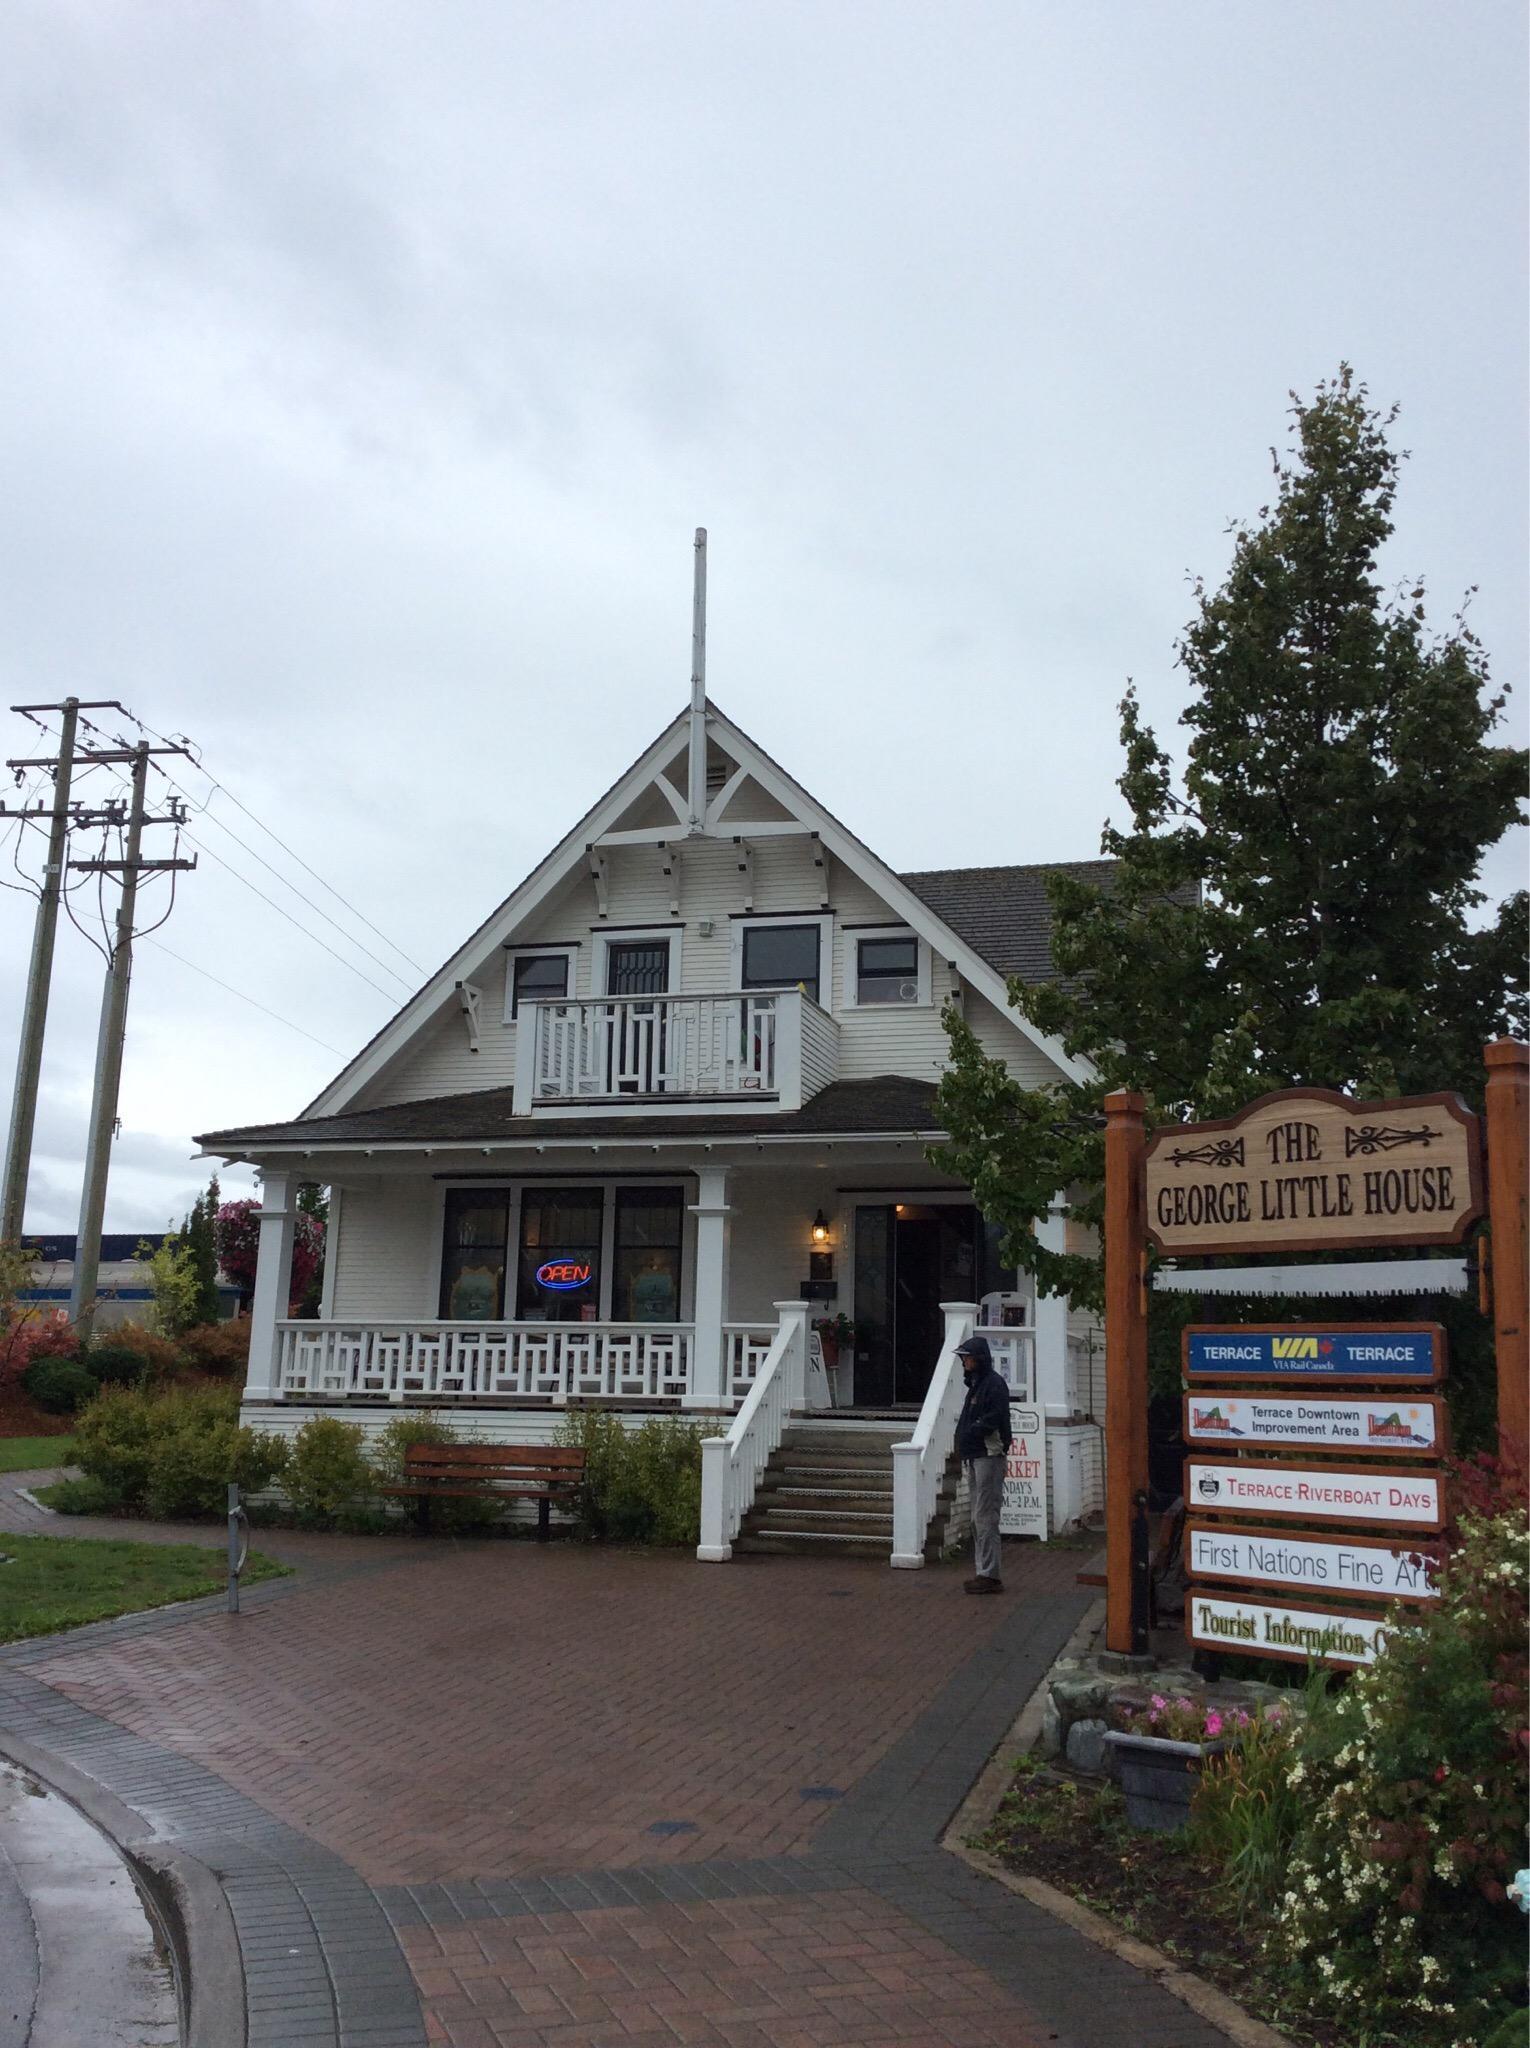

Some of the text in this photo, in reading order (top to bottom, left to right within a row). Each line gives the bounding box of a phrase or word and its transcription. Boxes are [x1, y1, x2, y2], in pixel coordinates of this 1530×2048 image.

[1266, 1122, 1323, 1164] THE
[1157, 1166, 1456, 1228] GEORGE LITTLE HOUSE
[540, 1265, 589, 1281] OPEN
[1203, 1346, 1262, 1360] TERRACE
[1272, 1337, 1319, 1359] VIA
[1346, 1346, 1415, 1361] TERRACE
[1273, 1360, 1335, 1371] VIA Rail Canada
[1251, 1405, 1360, 1420] Terrace Downtown
[1252, 1421, 1327, 1435] Improvement
[1331, 1424, 1360, 1436] Area
[1227, 1478, 1431, 1508] TERRACE RIVERBOAT DAYS
[1199, 1538, 1239, 1569] First
[1248, 1544, 1328, 1579] Nations
[1338, 1552, 1384, 1585] Fine
[1199, 1604, 1257, 1641] Tourist
